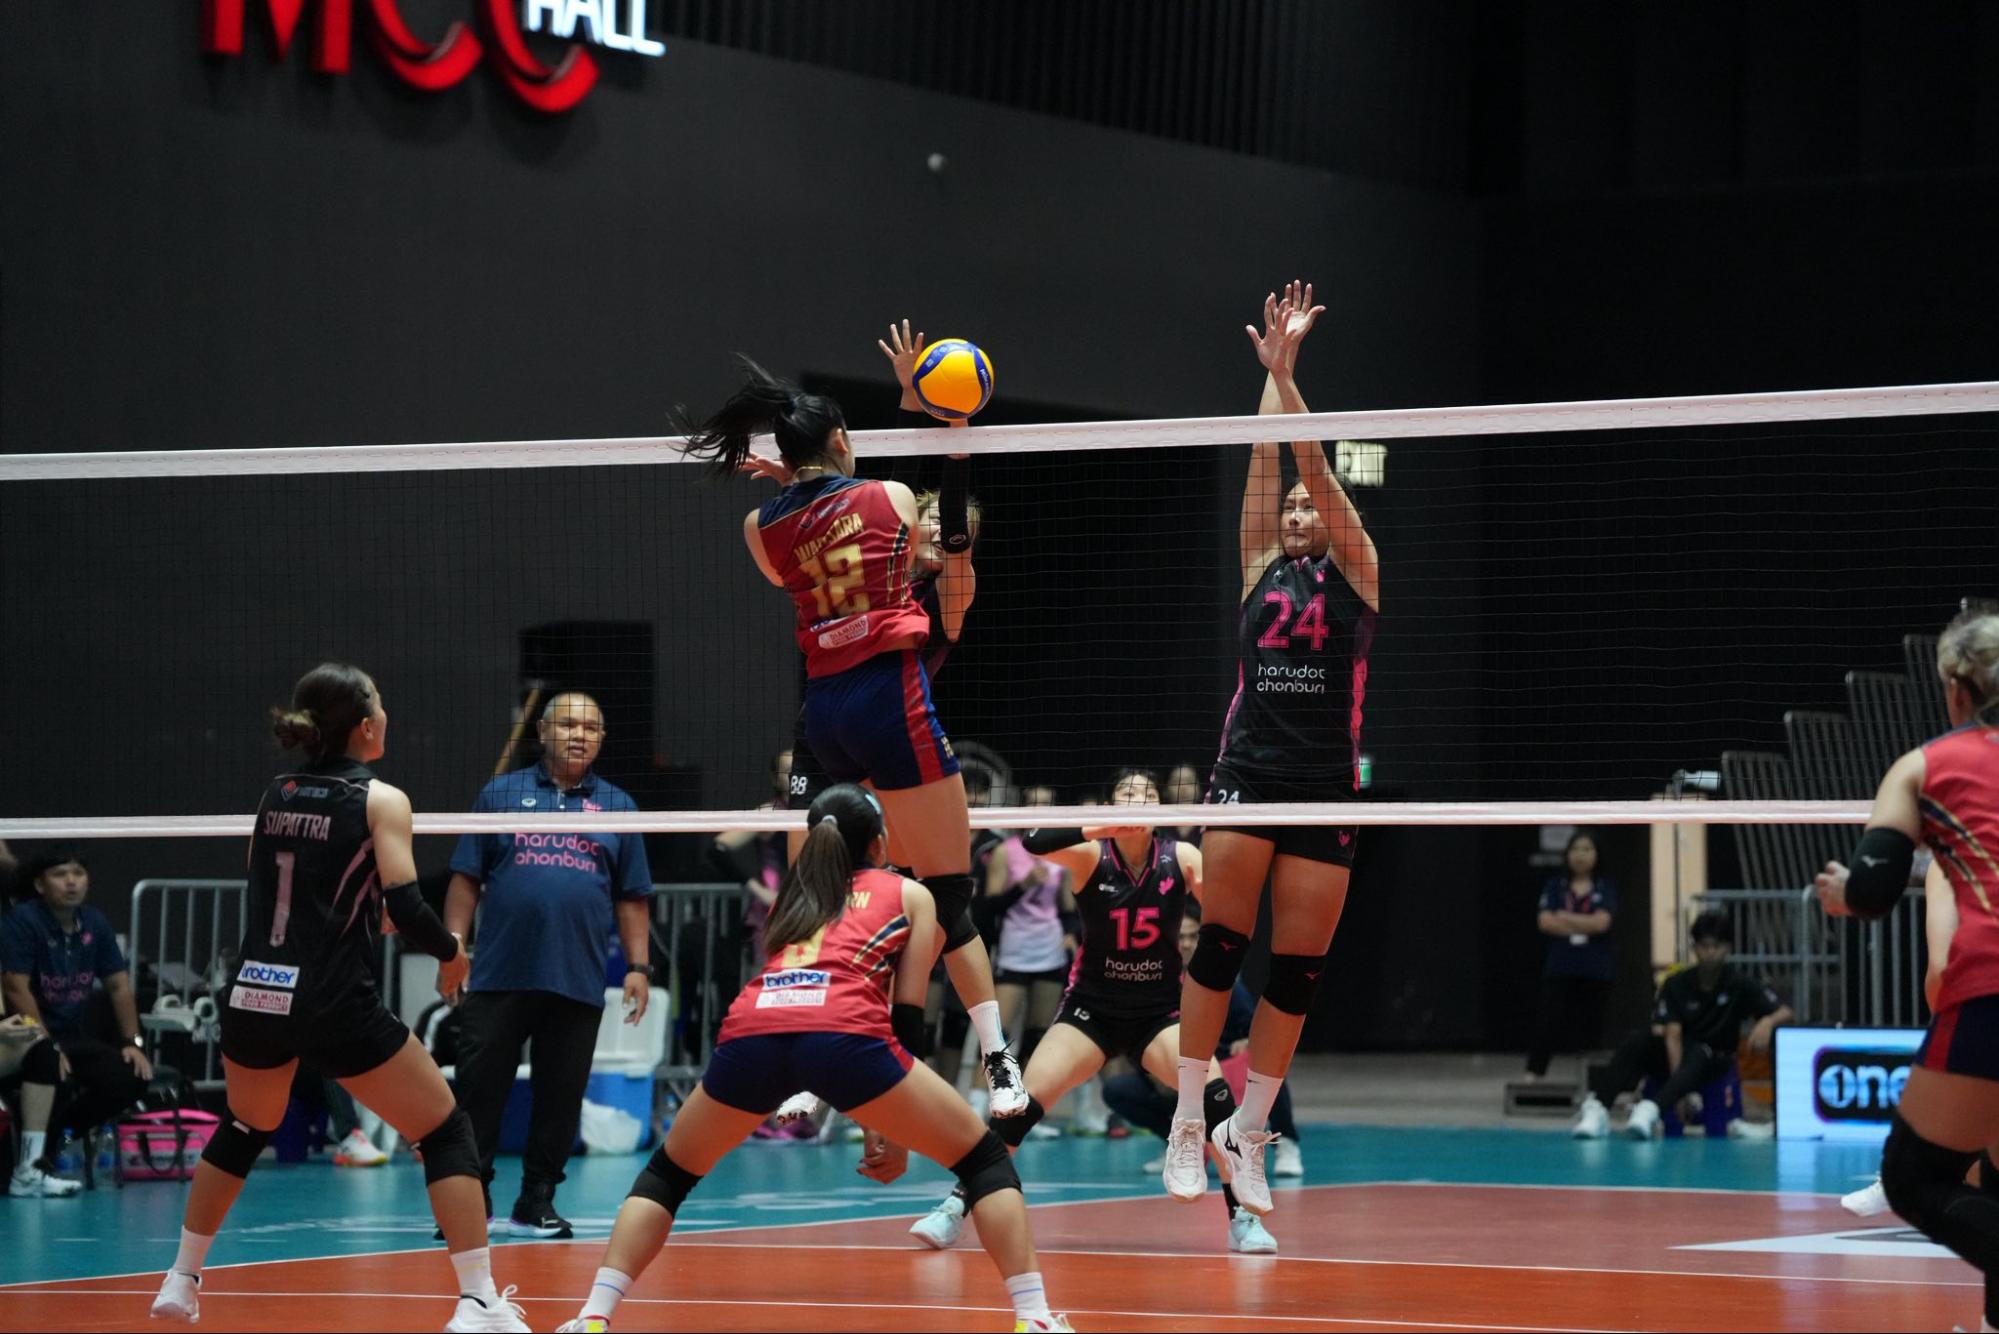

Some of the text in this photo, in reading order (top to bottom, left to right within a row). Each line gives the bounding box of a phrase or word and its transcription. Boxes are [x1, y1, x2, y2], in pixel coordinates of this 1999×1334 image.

[1257, 591, 1329, 650] 24
[790, 775, 808, 795] 88
[264, 810, 332, 841] SUPATTRA
[269, 851, 296, 948] 1
[1109, 907, 1161, 950] 15
[242, 965, 296, 984] rother
[766, 971, 828, 987] brother
